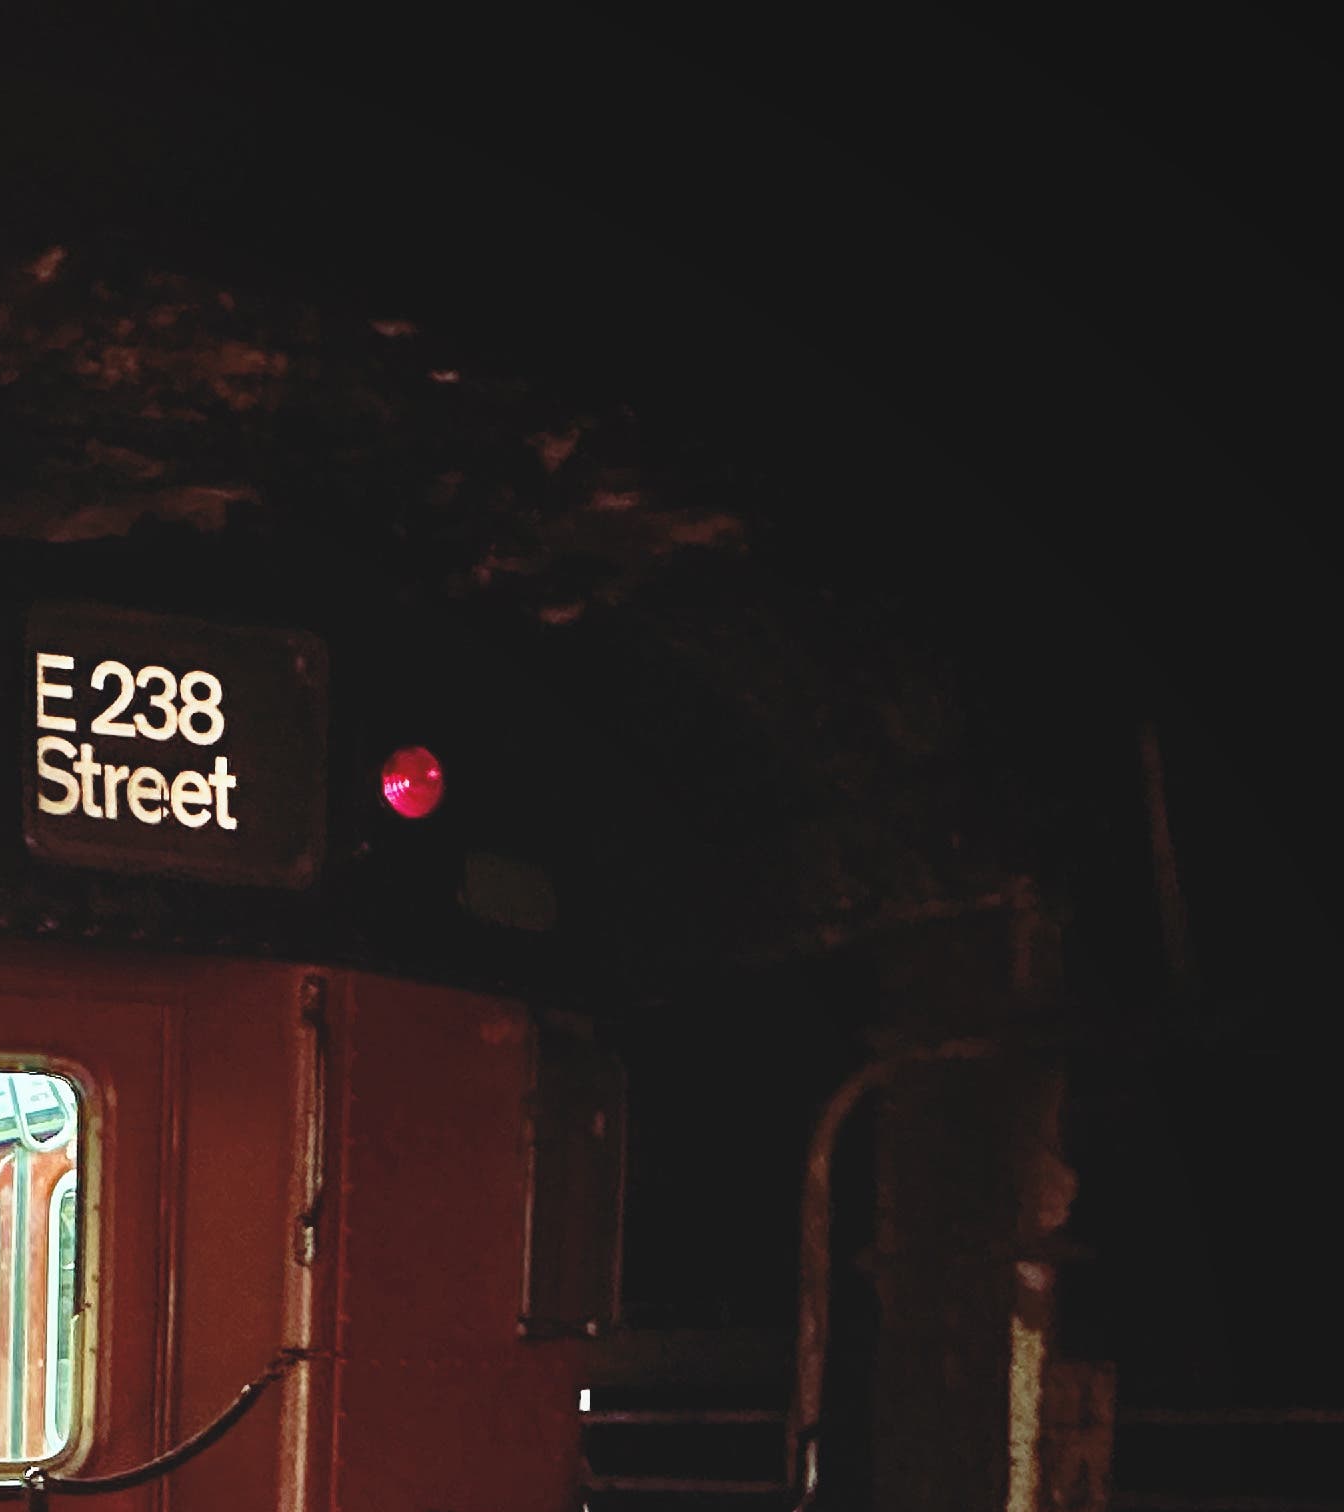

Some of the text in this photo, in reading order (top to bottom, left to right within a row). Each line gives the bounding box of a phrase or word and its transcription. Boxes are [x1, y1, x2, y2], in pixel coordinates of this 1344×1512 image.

[35, 652, 226, 746] E 238
[36, 735, 238, 830] Street
